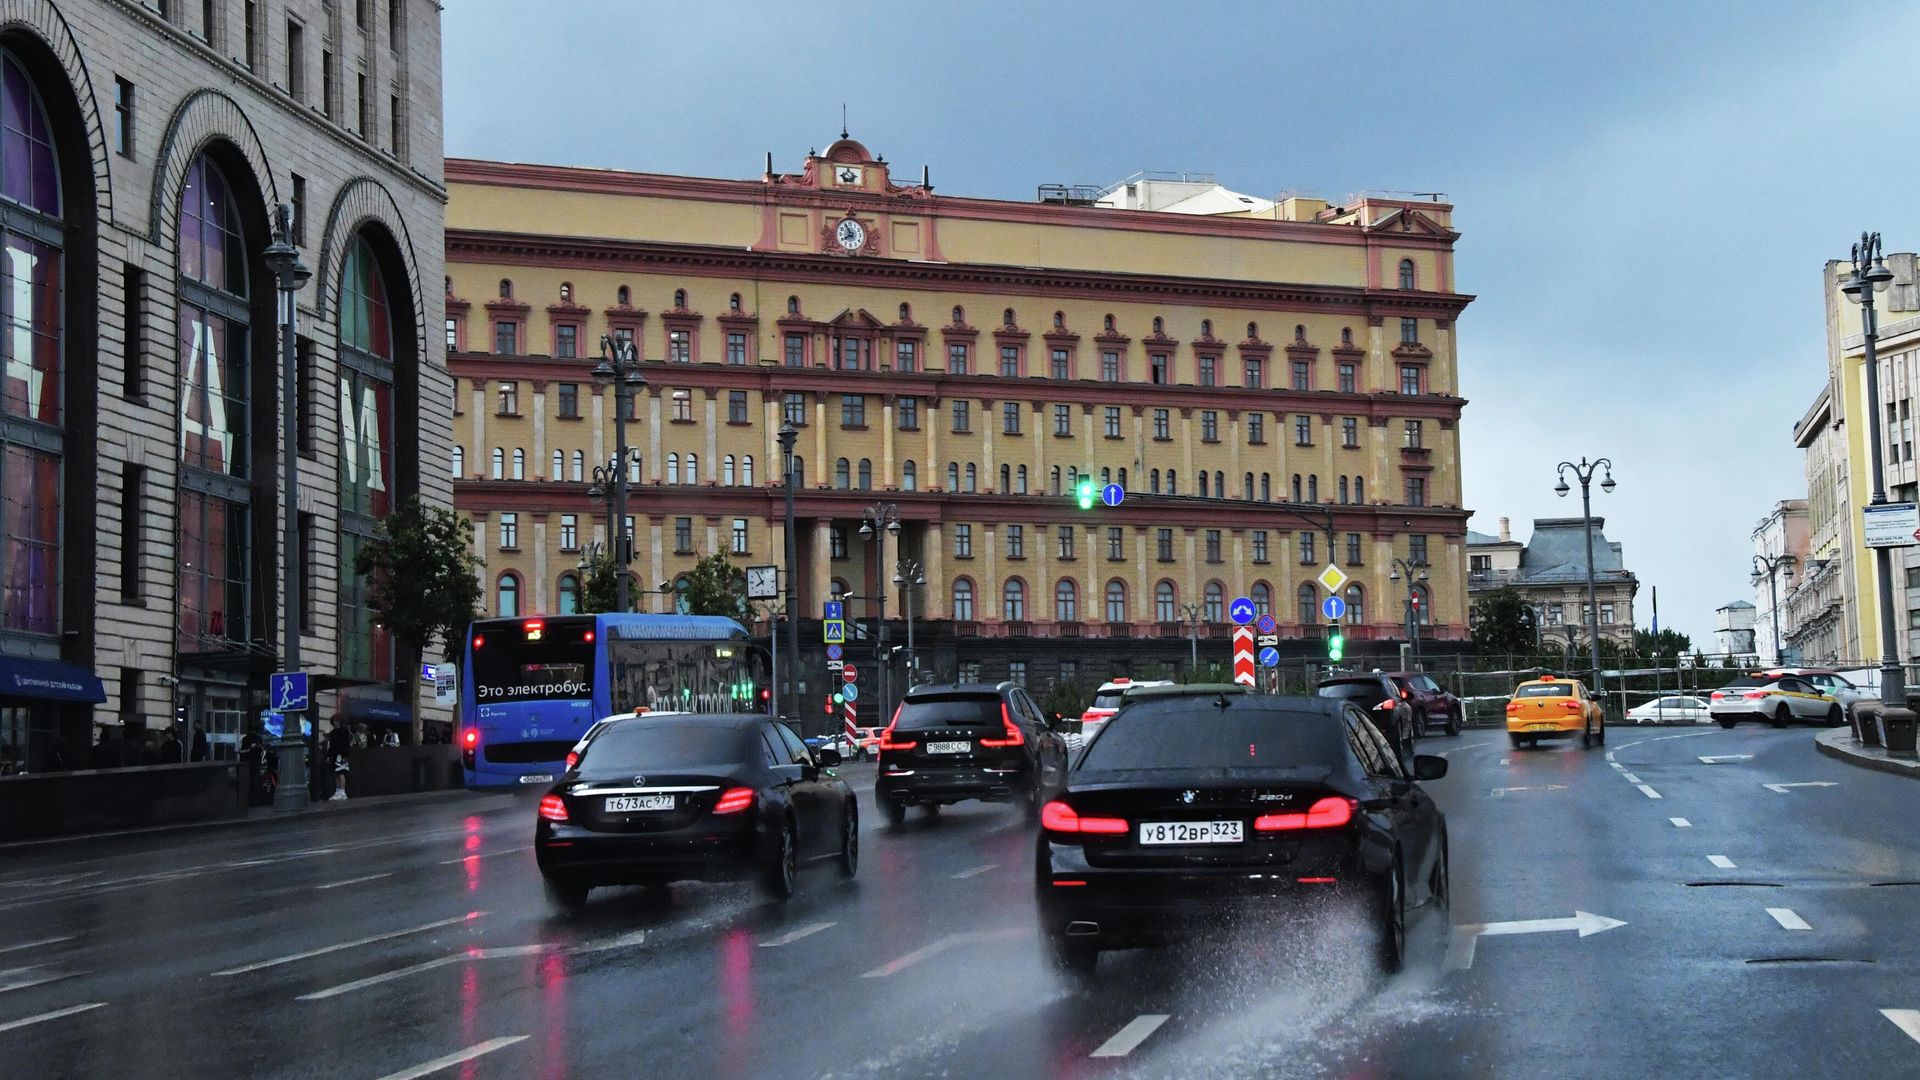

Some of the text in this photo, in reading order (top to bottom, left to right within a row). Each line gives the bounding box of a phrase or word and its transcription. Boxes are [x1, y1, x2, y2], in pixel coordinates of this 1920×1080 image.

[478, 680, 591, 698] Это электробус.
[654, 796, 672, 805] 977
[1213, 822, 1238, 835] 323
